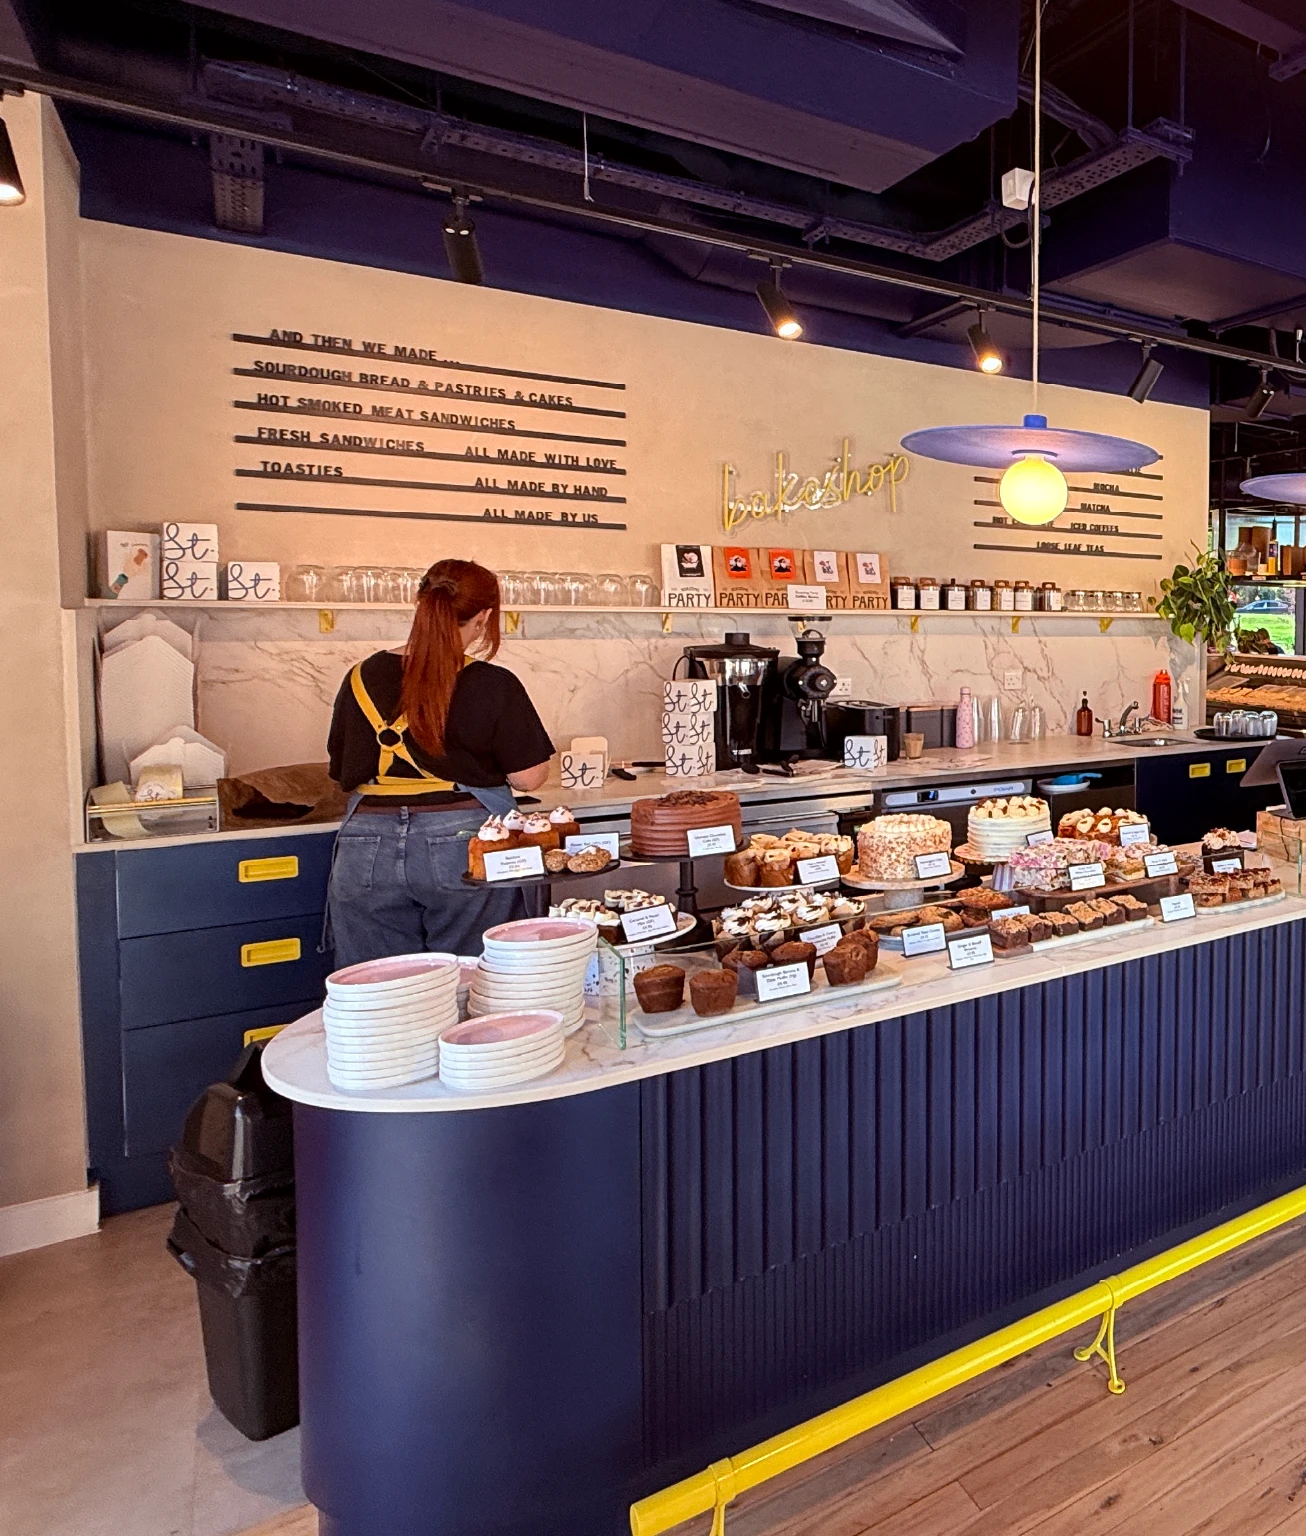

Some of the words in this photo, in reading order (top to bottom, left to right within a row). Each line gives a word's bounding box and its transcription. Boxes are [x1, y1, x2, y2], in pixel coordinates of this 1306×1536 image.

[269, 329, 303, 344] AND
[311, 334, 352, 350] THEN
[362, 341, 386, 354] WE
[394, 345, 437, 361] MADE
[253, 360, 352, 382] SOURDOUGH
[359, 373, 410, 388] BREAD
[418, 380, 429, 390] &
[434, 382, 505, 399] PASTRIES
[514, 391, 524, 400] &
[528, 392, 573, 407] CAKES
[257, 393, 290, 407] HOT
[298, 398, 362, 415] SMOKED
[371, 405, 414, 420] MEAT
[420, 410, 515, 430] SANDWICHES
[257, 427, 310, 443] FRESH
[320, 433, 425, 452] SANDWICHES
[465, 445, 489, 458] ALL
[497, 448, 536, 462] MADE
[544, 453, 579, 466] WITH
[586, 457, 617, 470] LOVE
[261, 461, 343, 477] TOASTIES
[475, 477, 498, 488] ALL
[507, 480, 546, 493] MADE
[551, 483, 569, 495] BY
[574, 485, 607, 497] HAND
[723, 439, 909, 531] bakeshop
[1093, 483, 1120, 492] MOCHA
[1080, 503, 1111, 513] MATCHA
[483, 508, 507, 518] ALL
[514, 510, 553, 521] MADE
[560, 512, 577, 522] BY
[582, 513, 599, 523] US
[1070, 522, 1087, 531] ICED
[1090, 523, 1119, 533] COFFEES
[1036, 541, 1060, 550] LOOSE
[1064, 543, 1082, 551] LEAF
[1086, 544, 1105, 552] TEAS
[668, 593, 712, 607] PARTY
[719, 592, 760, 606] PARTY
[765, 593, 788, 606] PAR
[826, 595, 848, 609] RTY
[852, 595, 888, 609] PARTY
